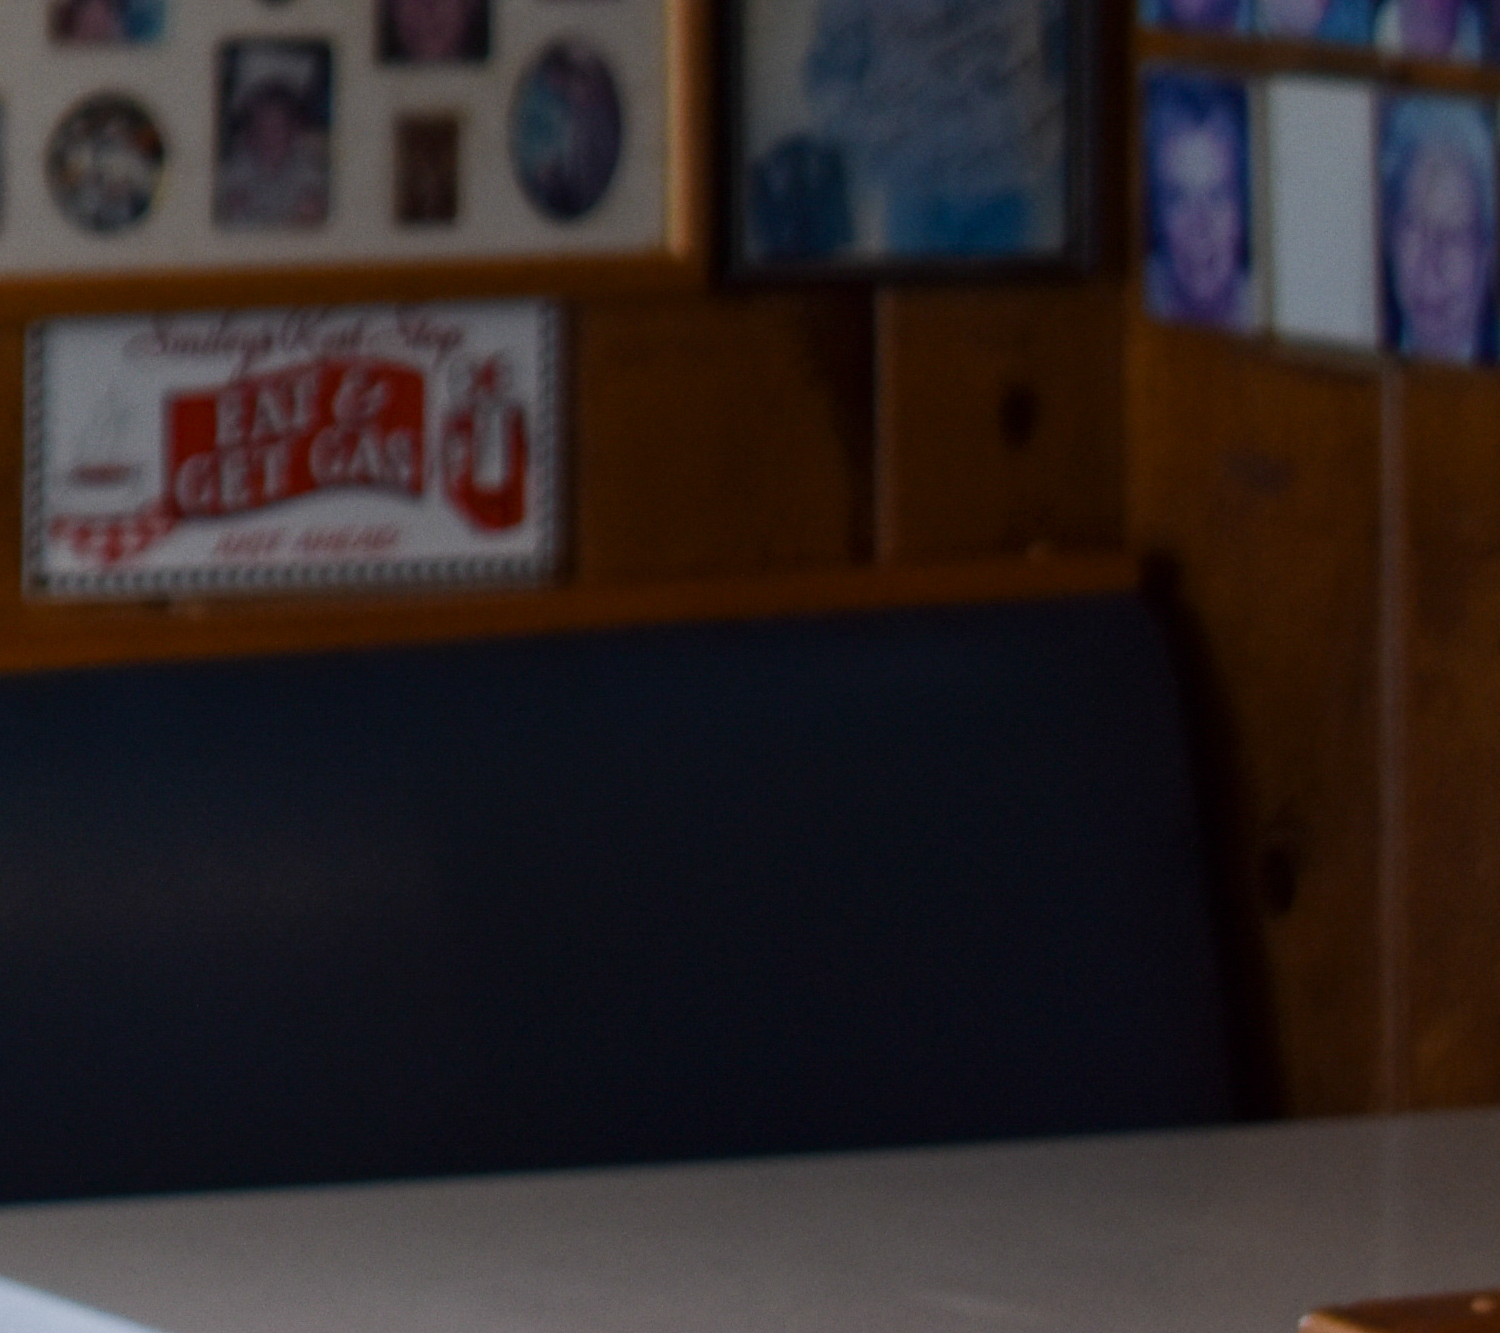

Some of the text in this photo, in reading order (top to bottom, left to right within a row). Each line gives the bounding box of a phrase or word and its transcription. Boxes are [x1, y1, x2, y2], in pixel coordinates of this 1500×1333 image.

[214, 365, 390, 445] EAT &
[173, 421, 415, 511] GET GAS
